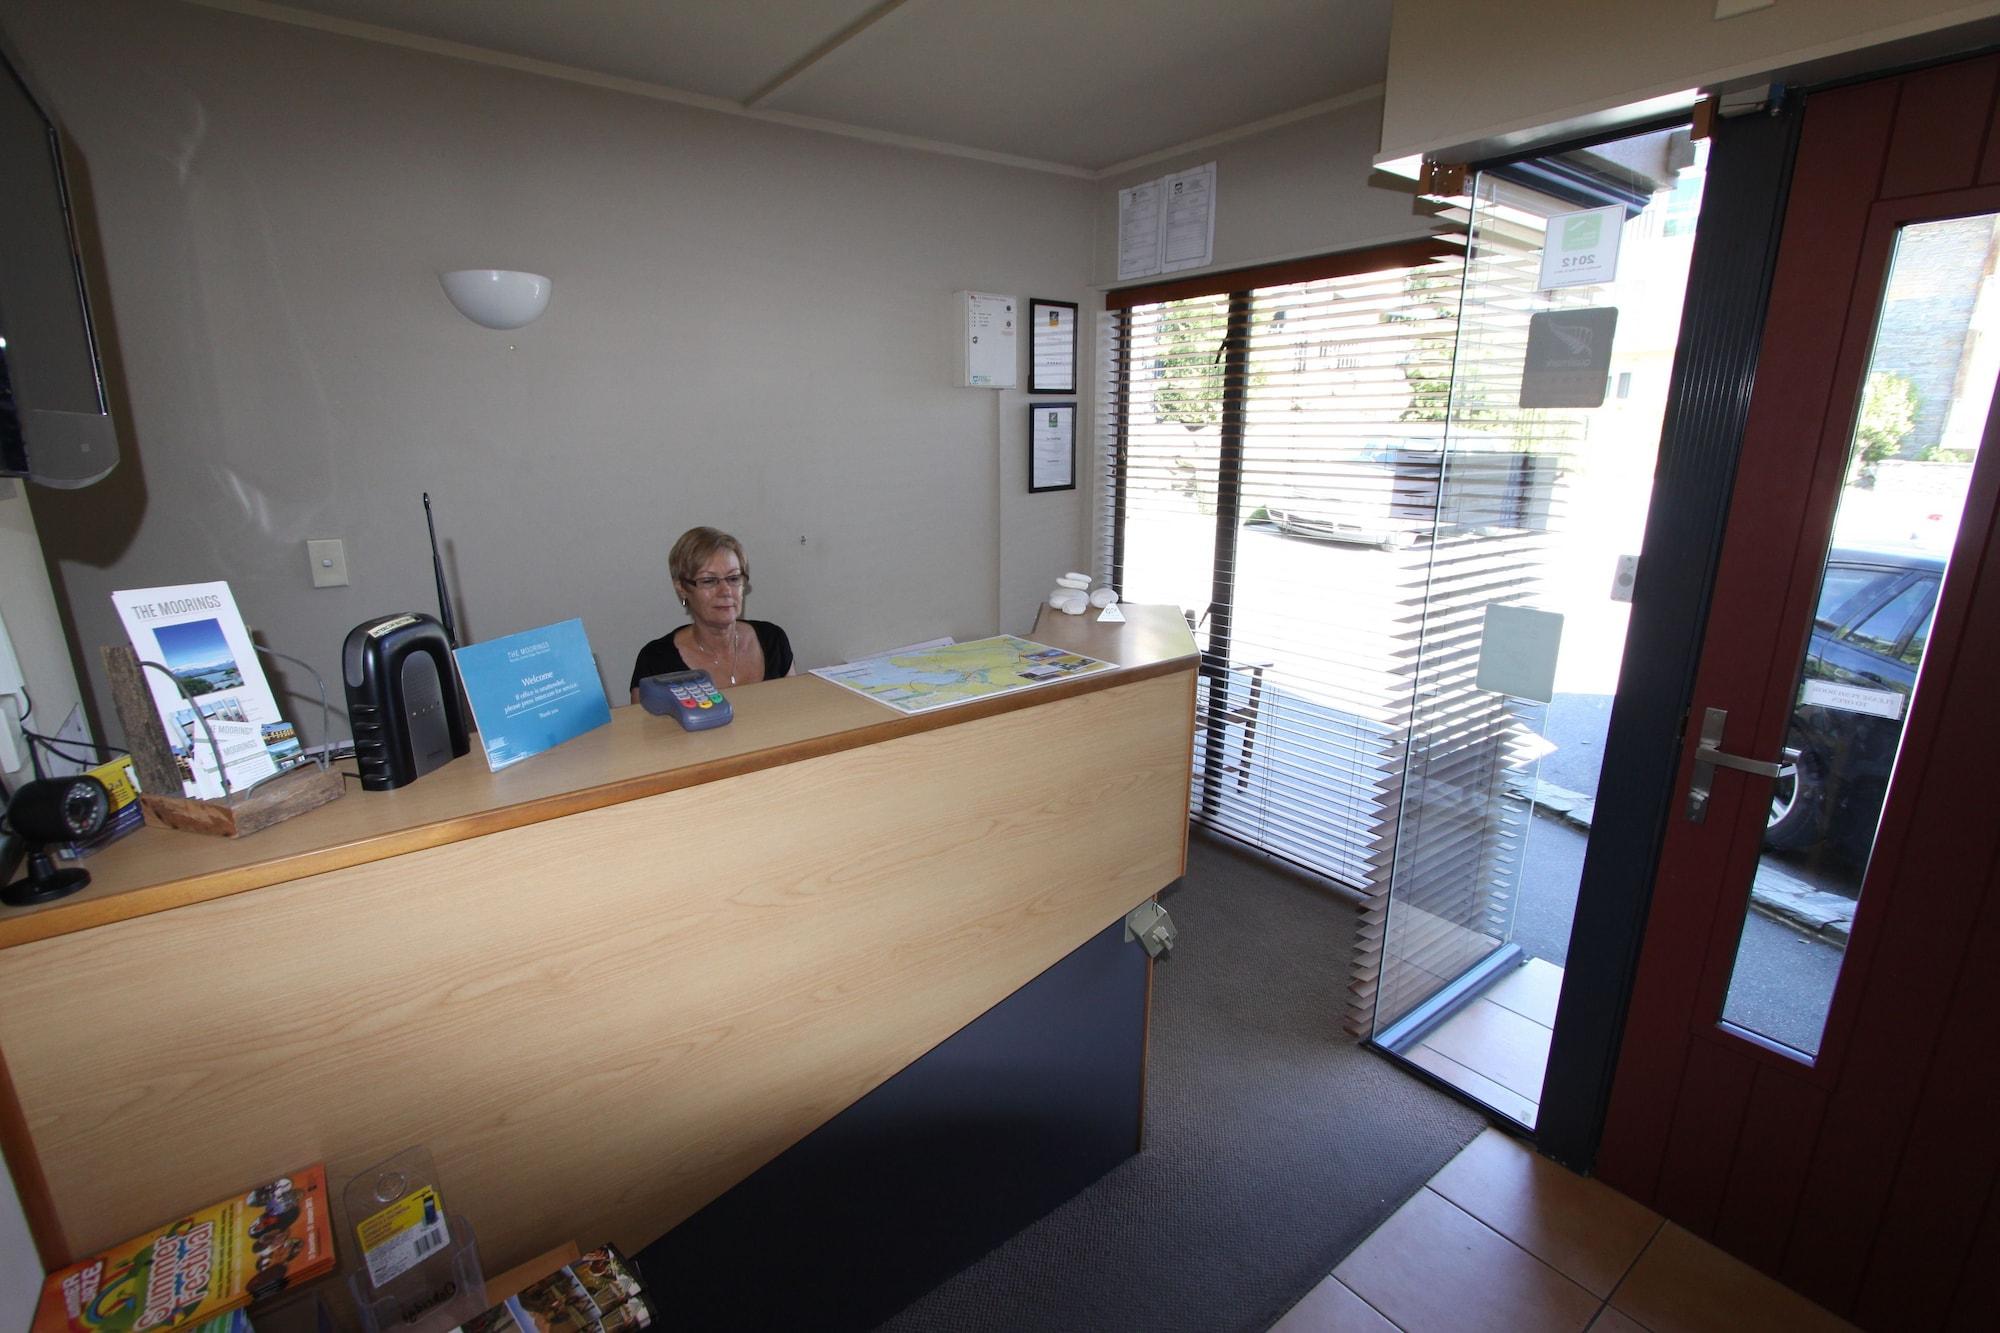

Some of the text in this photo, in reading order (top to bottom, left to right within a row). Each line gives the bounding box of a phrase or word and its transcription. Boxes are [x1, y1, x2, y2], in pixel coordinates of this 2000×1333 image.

[131, 595, 222, 620] THE MOORINGS
[521, 671, 554, 687] Welcome
[134, 1235, 178, 1331] Summer
[177, 1220, 214, 1307] Festival
